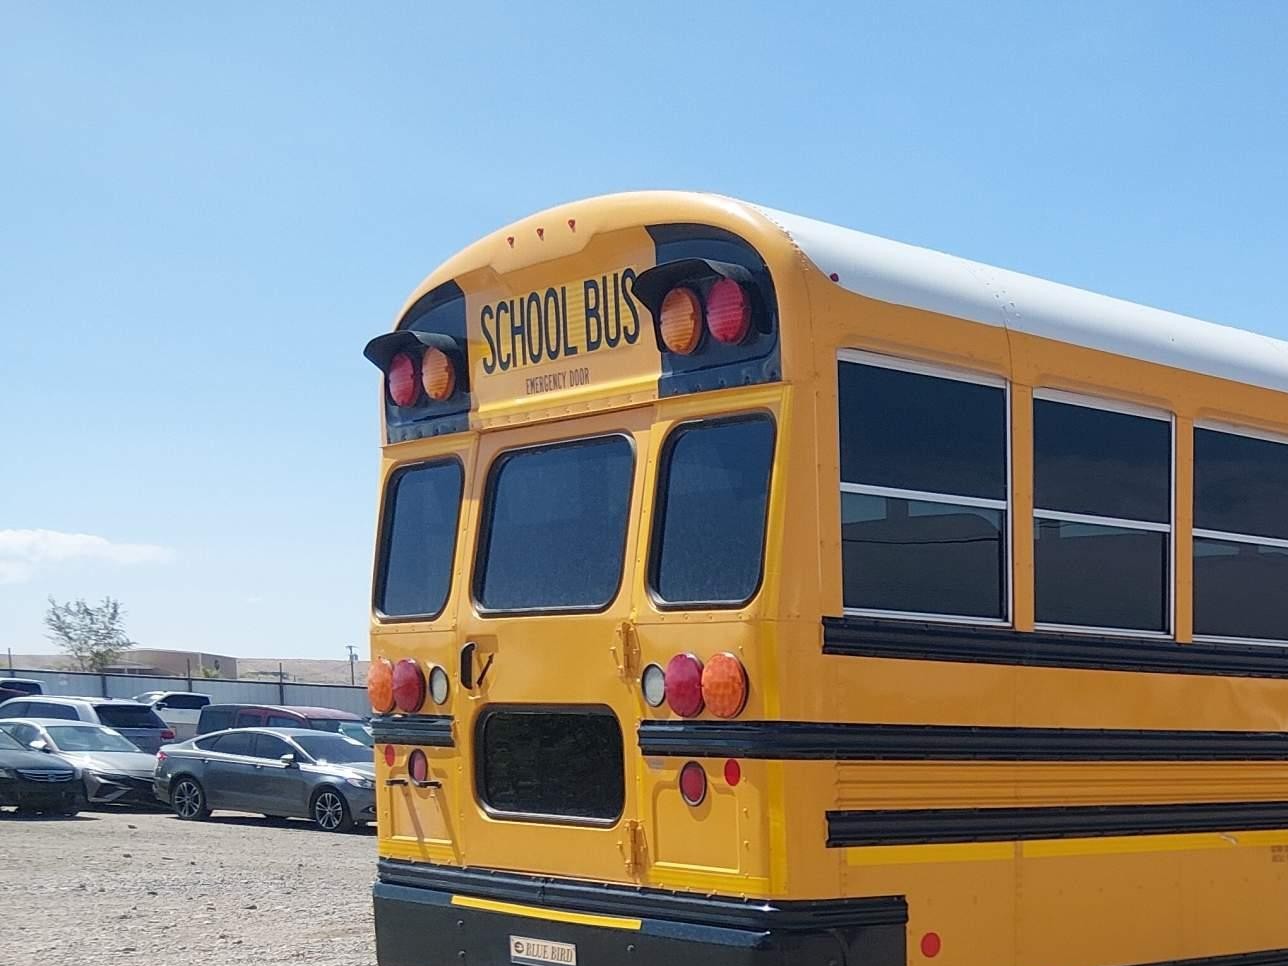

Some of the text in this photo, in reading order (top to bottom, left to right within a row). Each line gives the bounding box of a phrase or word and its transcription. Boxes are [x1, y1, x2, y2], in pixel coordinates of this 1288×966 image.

[480, 267, 641, 375] SCHOOL BUS
[525, 367, 590, 395] EMERGENCY DOOR
[526, 942, 573, 962] BLUE BIRD
